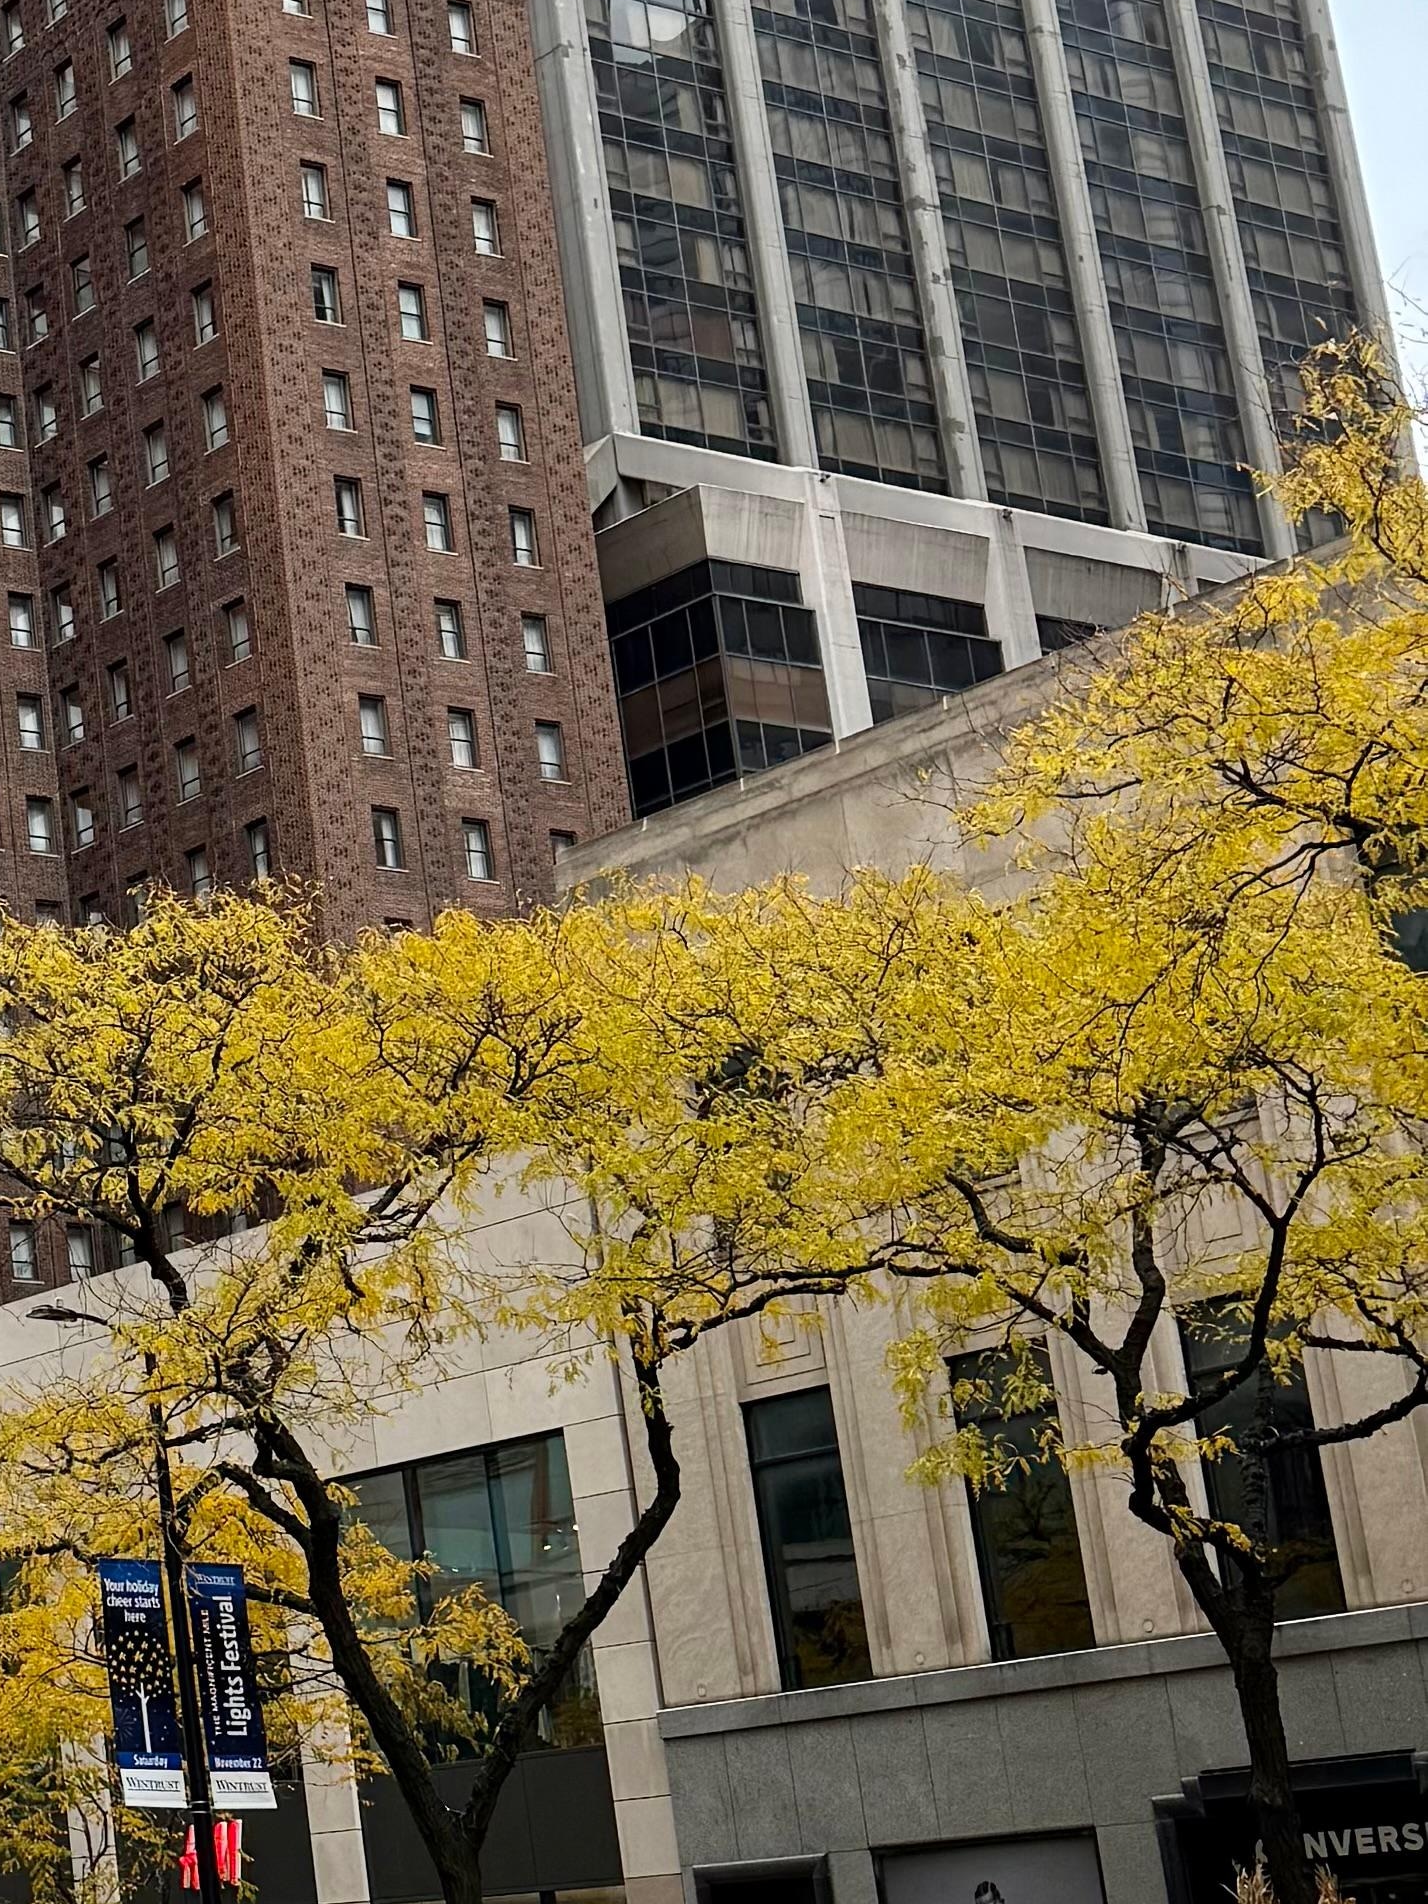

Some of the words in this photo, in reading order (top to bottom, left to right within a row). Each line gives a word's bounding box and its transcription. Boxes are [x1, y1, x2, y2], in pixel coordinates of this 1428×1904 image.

[104, 1578, 124, 1592] Your
[125, 1579, 159, 1596] holiday
[107, 1593, 132, 1607] cheer
[134, 1596, 160, 1608] starts
[124, 1609, 147, 1623] here
[201, 1609, 211, 1635] MILE
[212, 1596, 242, 1671] Festival
[223, 1676, 252, 1736] Lights
[213, 1715, 223, 1736] THE
[133, 1754, 168, 1768] Saturday
[252, 1757, 263, 1769] 22
[126, 1777, 180, 1790] WINTRUST
[216, 1779, 267, 1792] WINTRUST
[1255, 1820, 1428, 1863] NVERS
